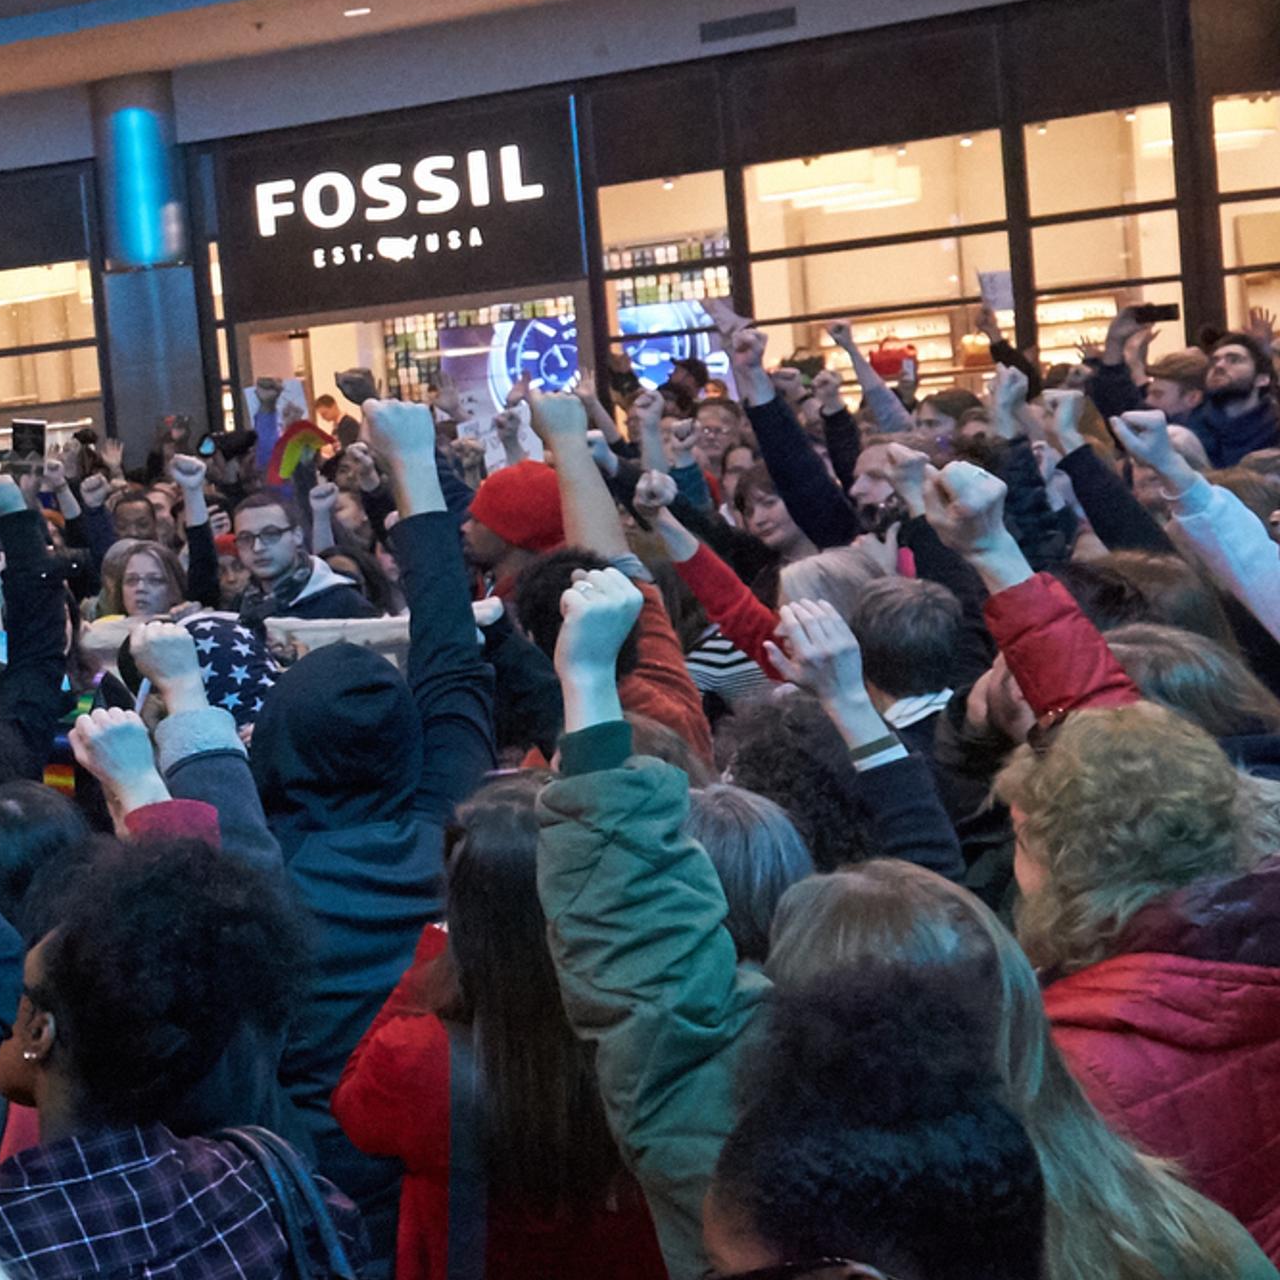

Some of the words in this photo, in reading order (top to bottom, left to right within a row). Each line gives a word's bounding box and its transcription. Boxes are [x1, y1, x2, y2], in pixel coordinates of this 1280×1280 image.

[254, 144, 544, 237] FOSSIL
[313, 243, 375, 268] EST.
[425, 227, 483, 253] USA
